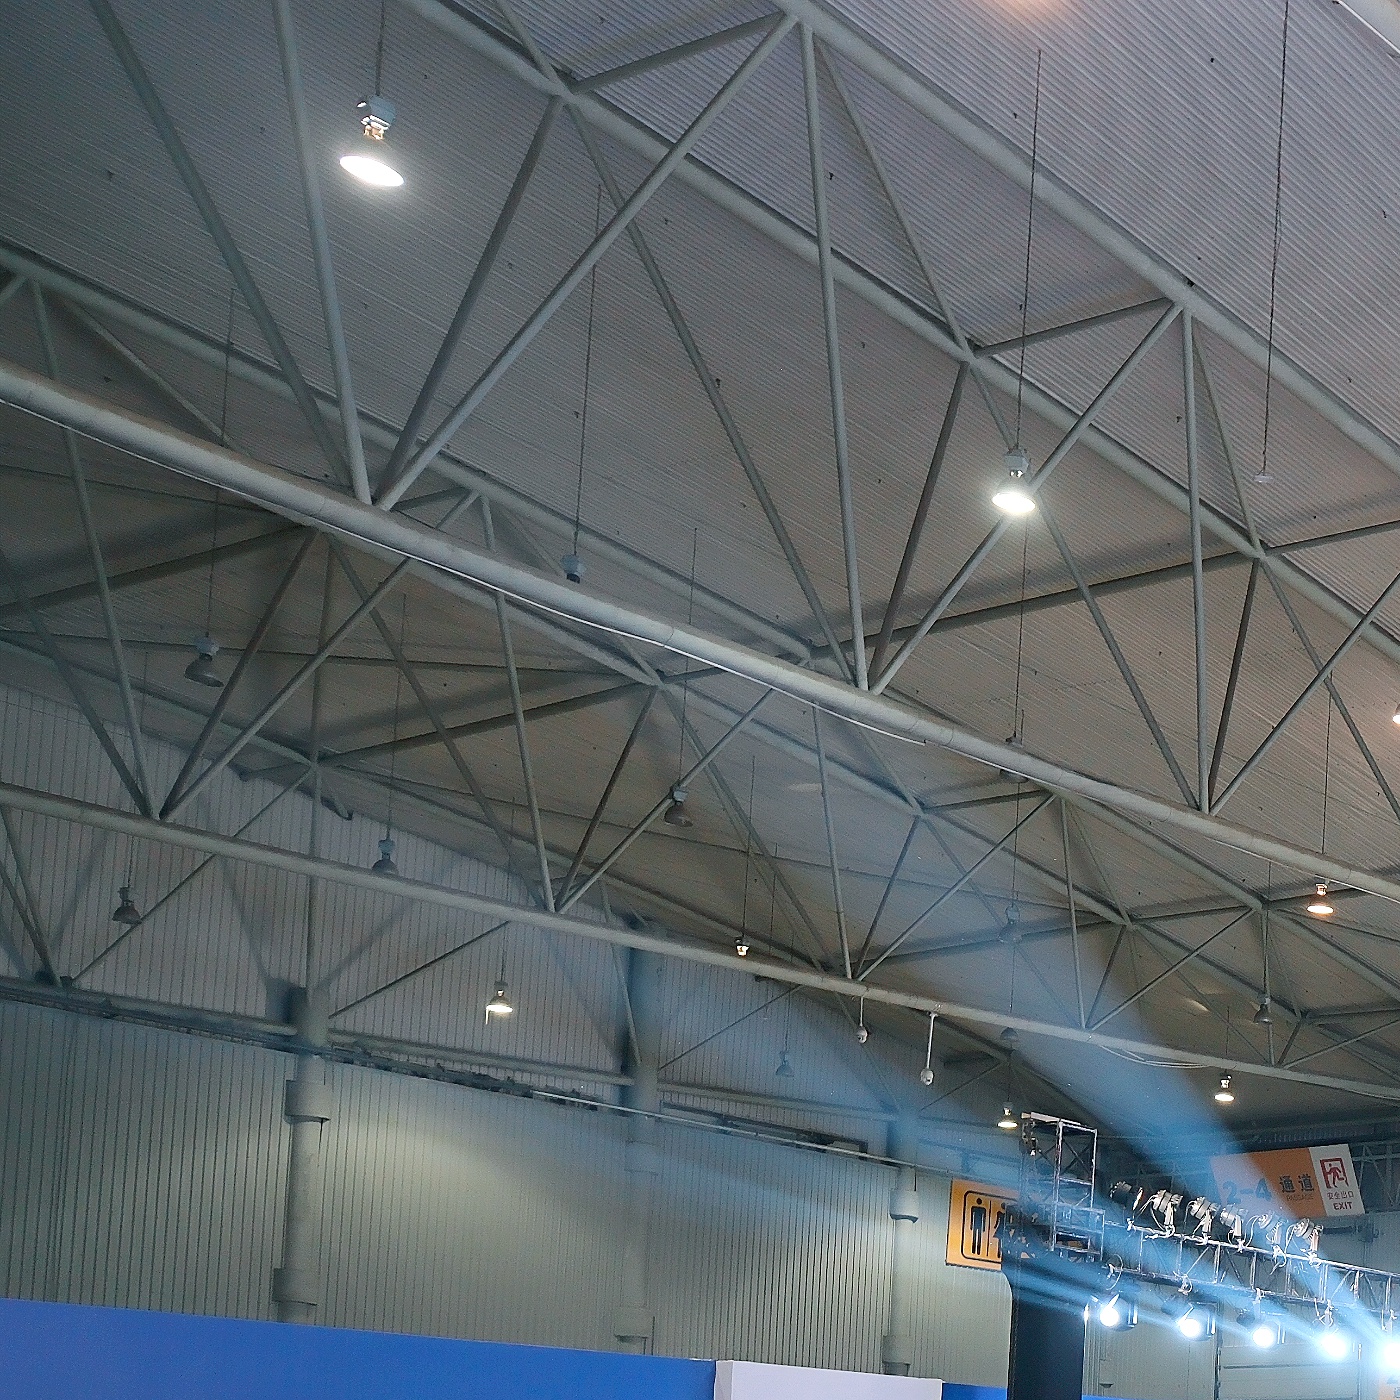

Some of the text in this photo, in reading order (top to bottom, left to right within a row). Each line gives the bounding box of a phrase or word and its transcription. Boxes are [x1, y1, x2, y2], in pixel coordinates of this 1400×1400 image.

[1222, 1178, 1273, 1205] 2-4
[1279, 1173, 1315, 1194] 通道
[1326, 1190, 1354, 1201] 安全出口
[1333, 1201, 1353, 1211] EXIT
